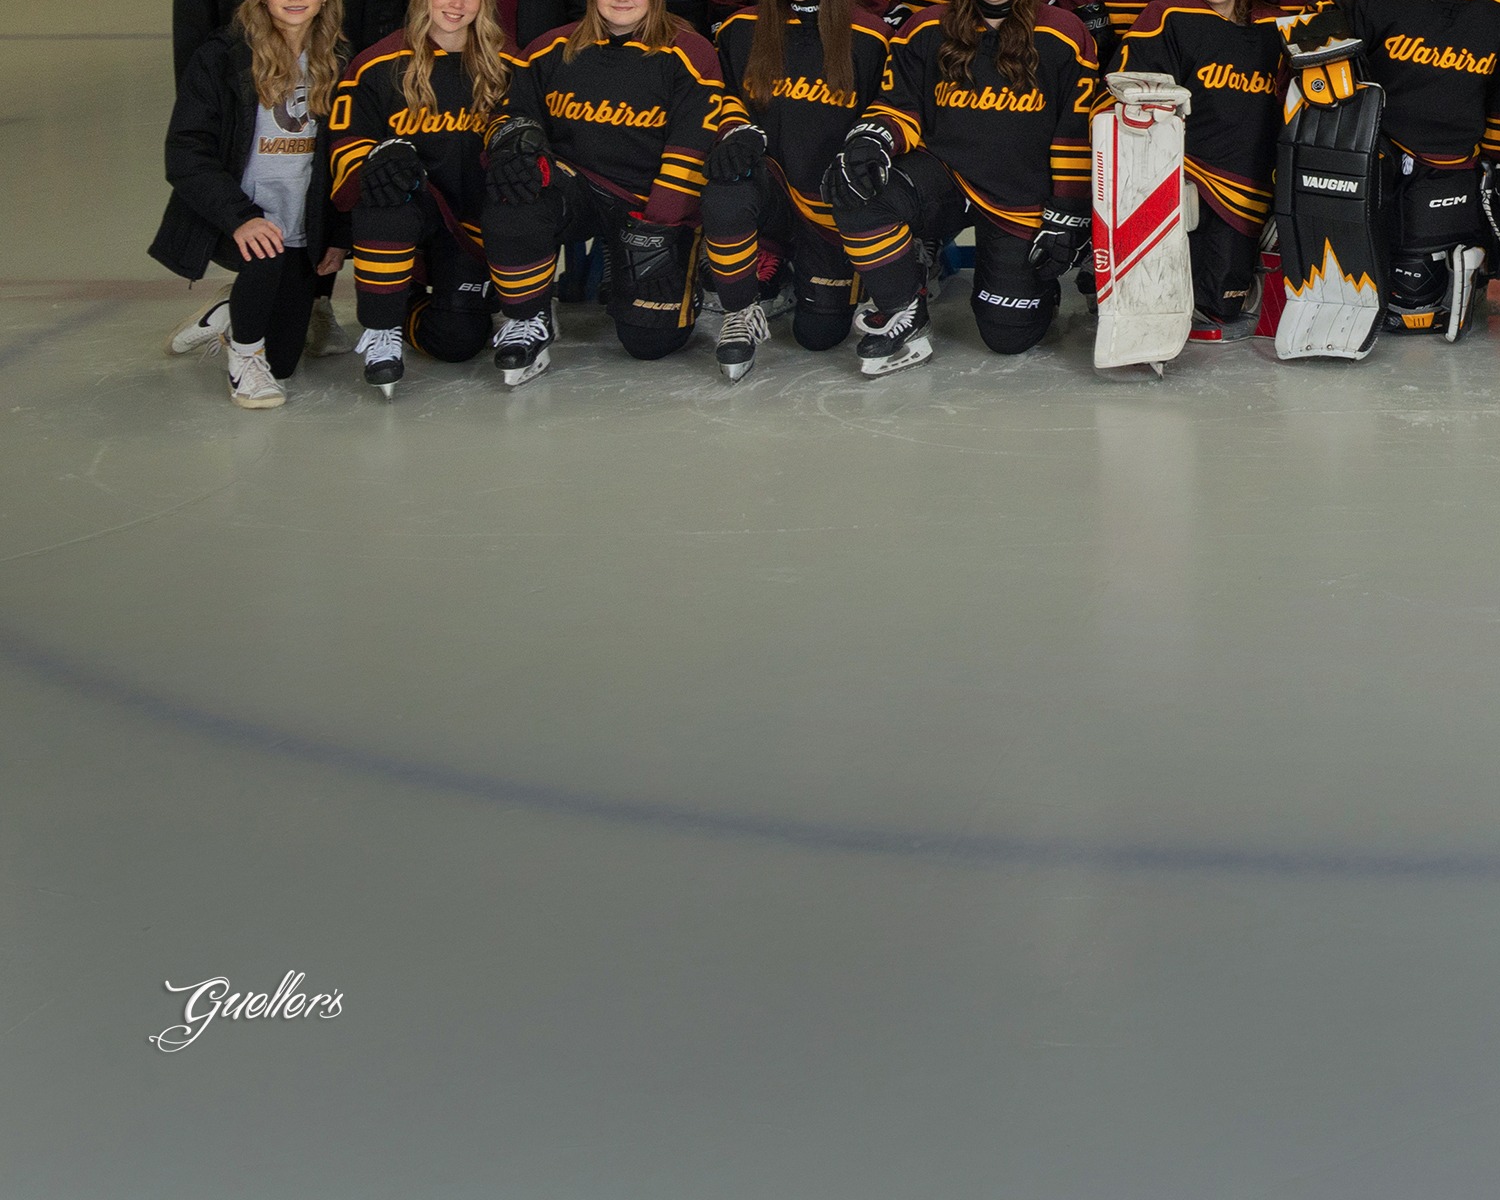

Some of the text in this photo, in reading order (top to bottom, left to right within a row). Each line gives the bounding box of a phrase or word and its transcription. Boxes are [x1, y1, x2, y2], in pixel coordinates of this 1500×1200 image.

[1385, 33, 1498, 76] Warbirds
[545, 90, 668, 128] Warbirds
[934, 80, 1047, 113] Warbirds
[1072, 76, 1099, 114] 2
[701, 92, 723, 132] 2
[1096, 150, 1104, 201] WARRIOR
[1302, 174, 1359, 193] VAUGHN
[1429, 194, 1468, 208] CCM
[1042, 208, 1092, 229] AUER
[1394, 267, 1423, 279] PRO
[977, 289, 1041, 310] BAUER
